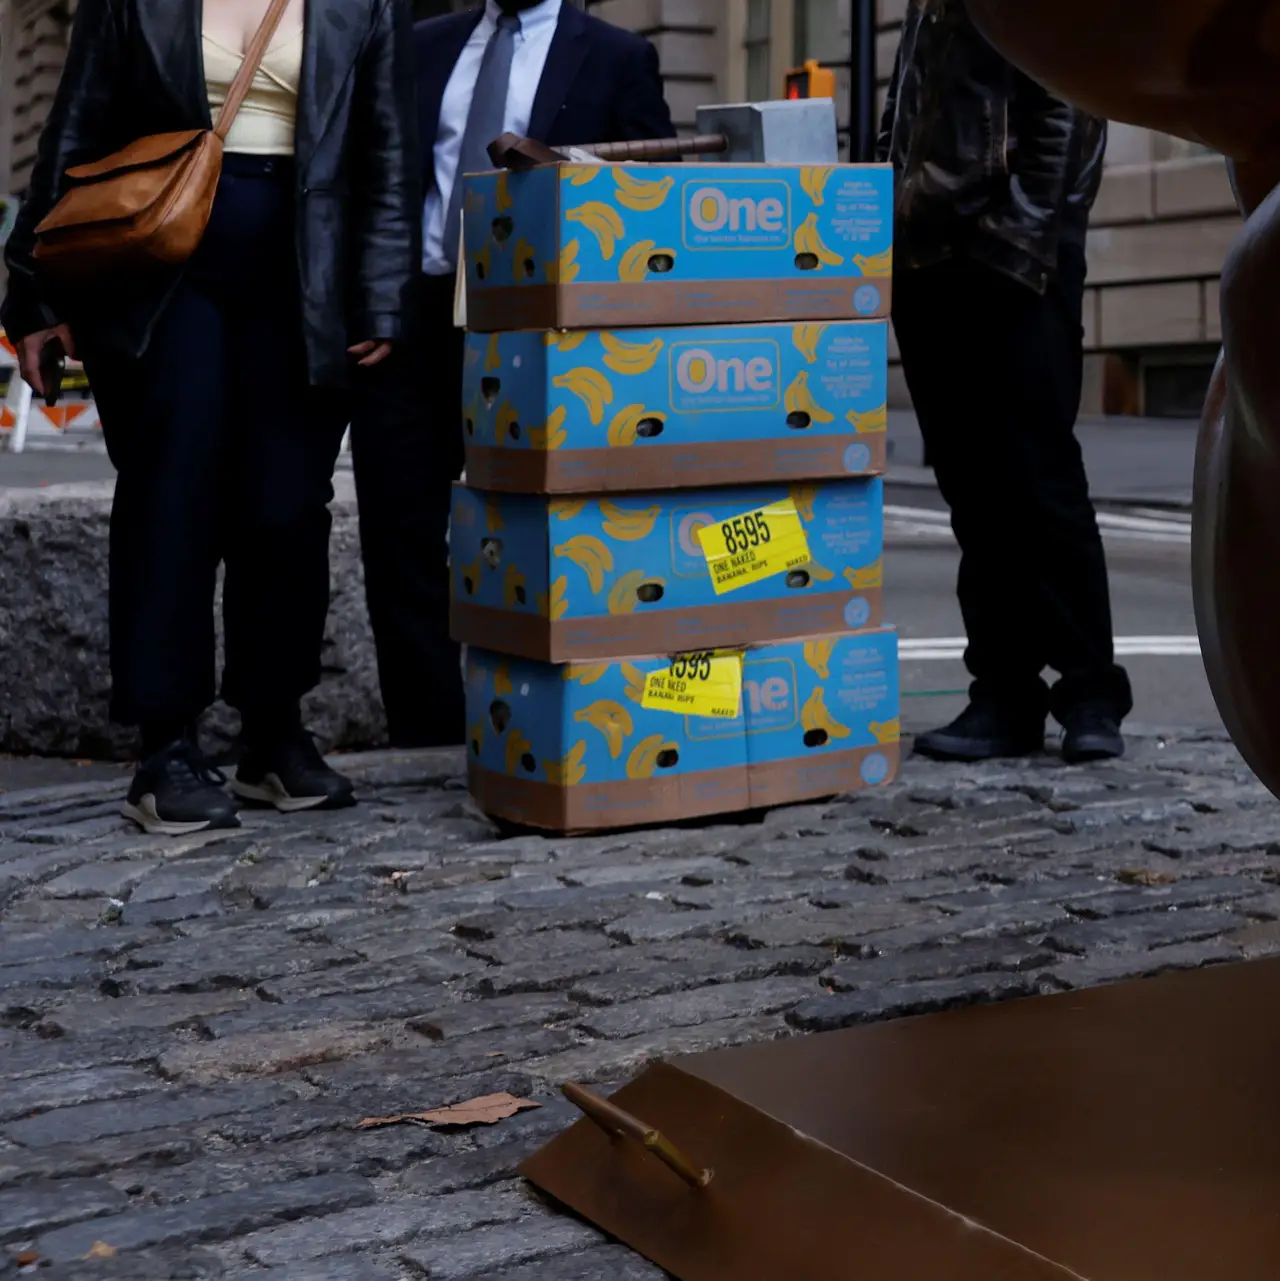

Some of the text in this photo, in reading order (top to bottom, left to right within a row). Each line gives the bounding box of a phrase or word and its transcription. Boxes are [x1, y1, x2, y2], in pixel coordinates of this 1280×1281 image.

[690, 187, 783, 231] One
[677, 349, 772, 394] One
[721, 512, 771, 555] 8595
[713, 560, 729, 574] ONE
[650, 676, 666, 689] ONE
[738, 676, 789, 714] ne
